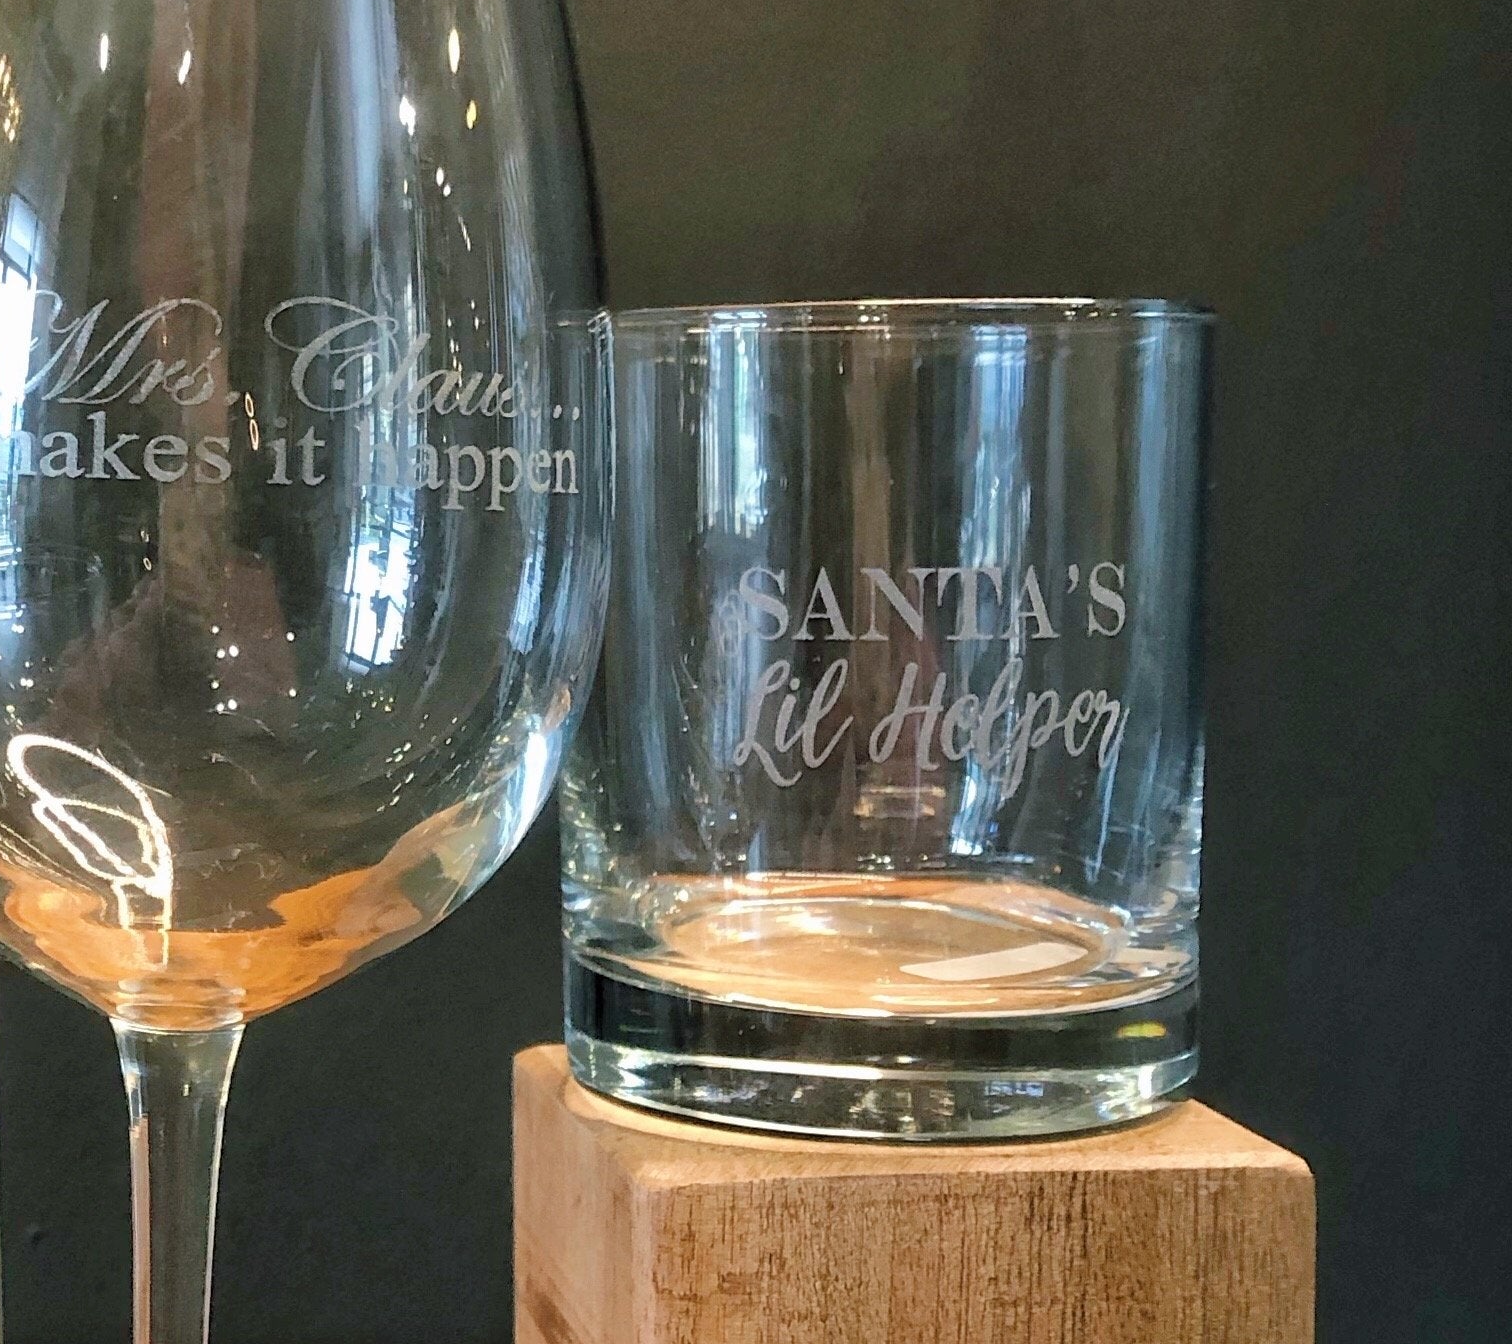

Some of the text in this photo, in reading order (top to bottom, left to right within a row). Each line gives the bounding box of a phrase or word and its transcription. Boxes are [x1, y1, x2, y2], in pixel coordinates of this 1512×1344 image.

[266, 416, 326, 486] it
[352, 419, 579, 512] happen
[738, 561, 1127, 642] SANTA'S
[734, 655, 1130, 808] Lil Helper
